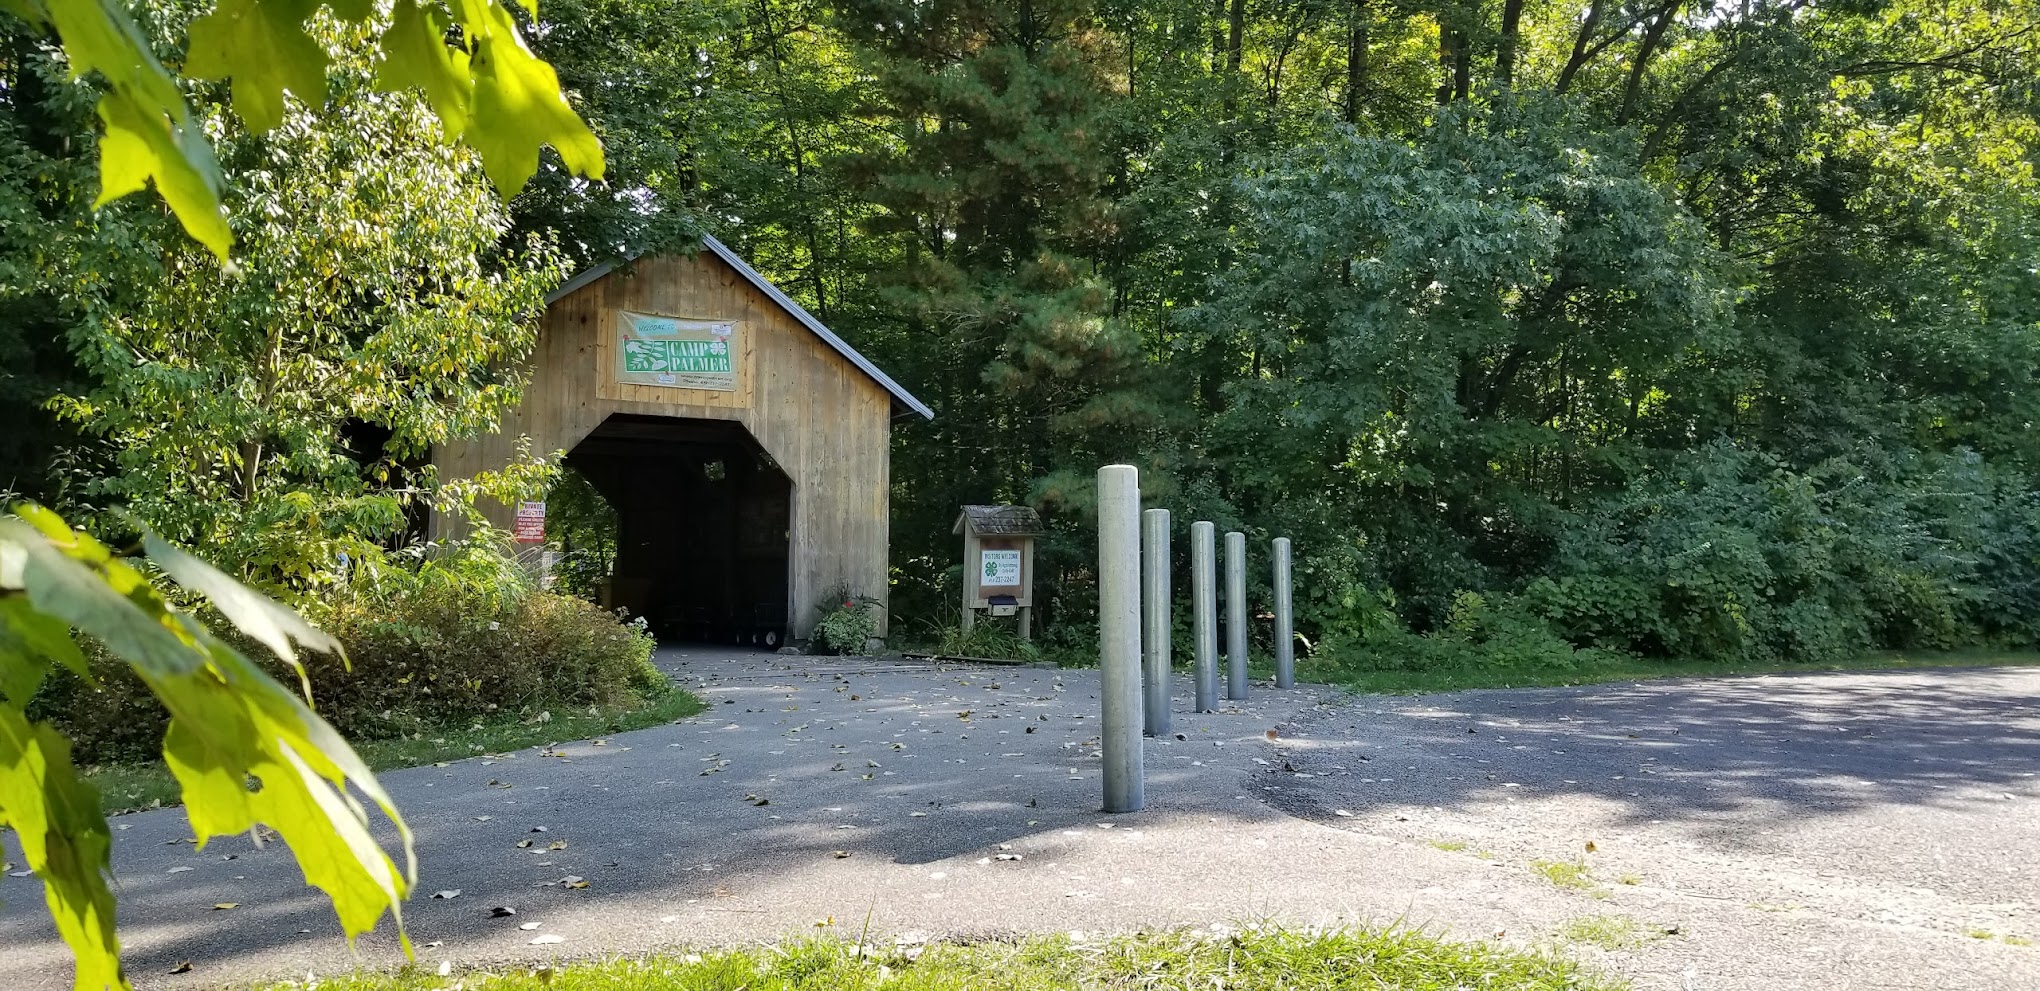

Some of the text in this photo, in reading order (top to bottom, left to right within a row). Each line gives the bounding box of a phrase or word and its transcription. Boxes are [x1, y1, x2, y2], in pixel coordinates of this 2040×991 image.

[638, 324, 665, 332] WELCOME
[671, 342, 708, 357] CAMP
[672, 357, 729, 371] PALMER
